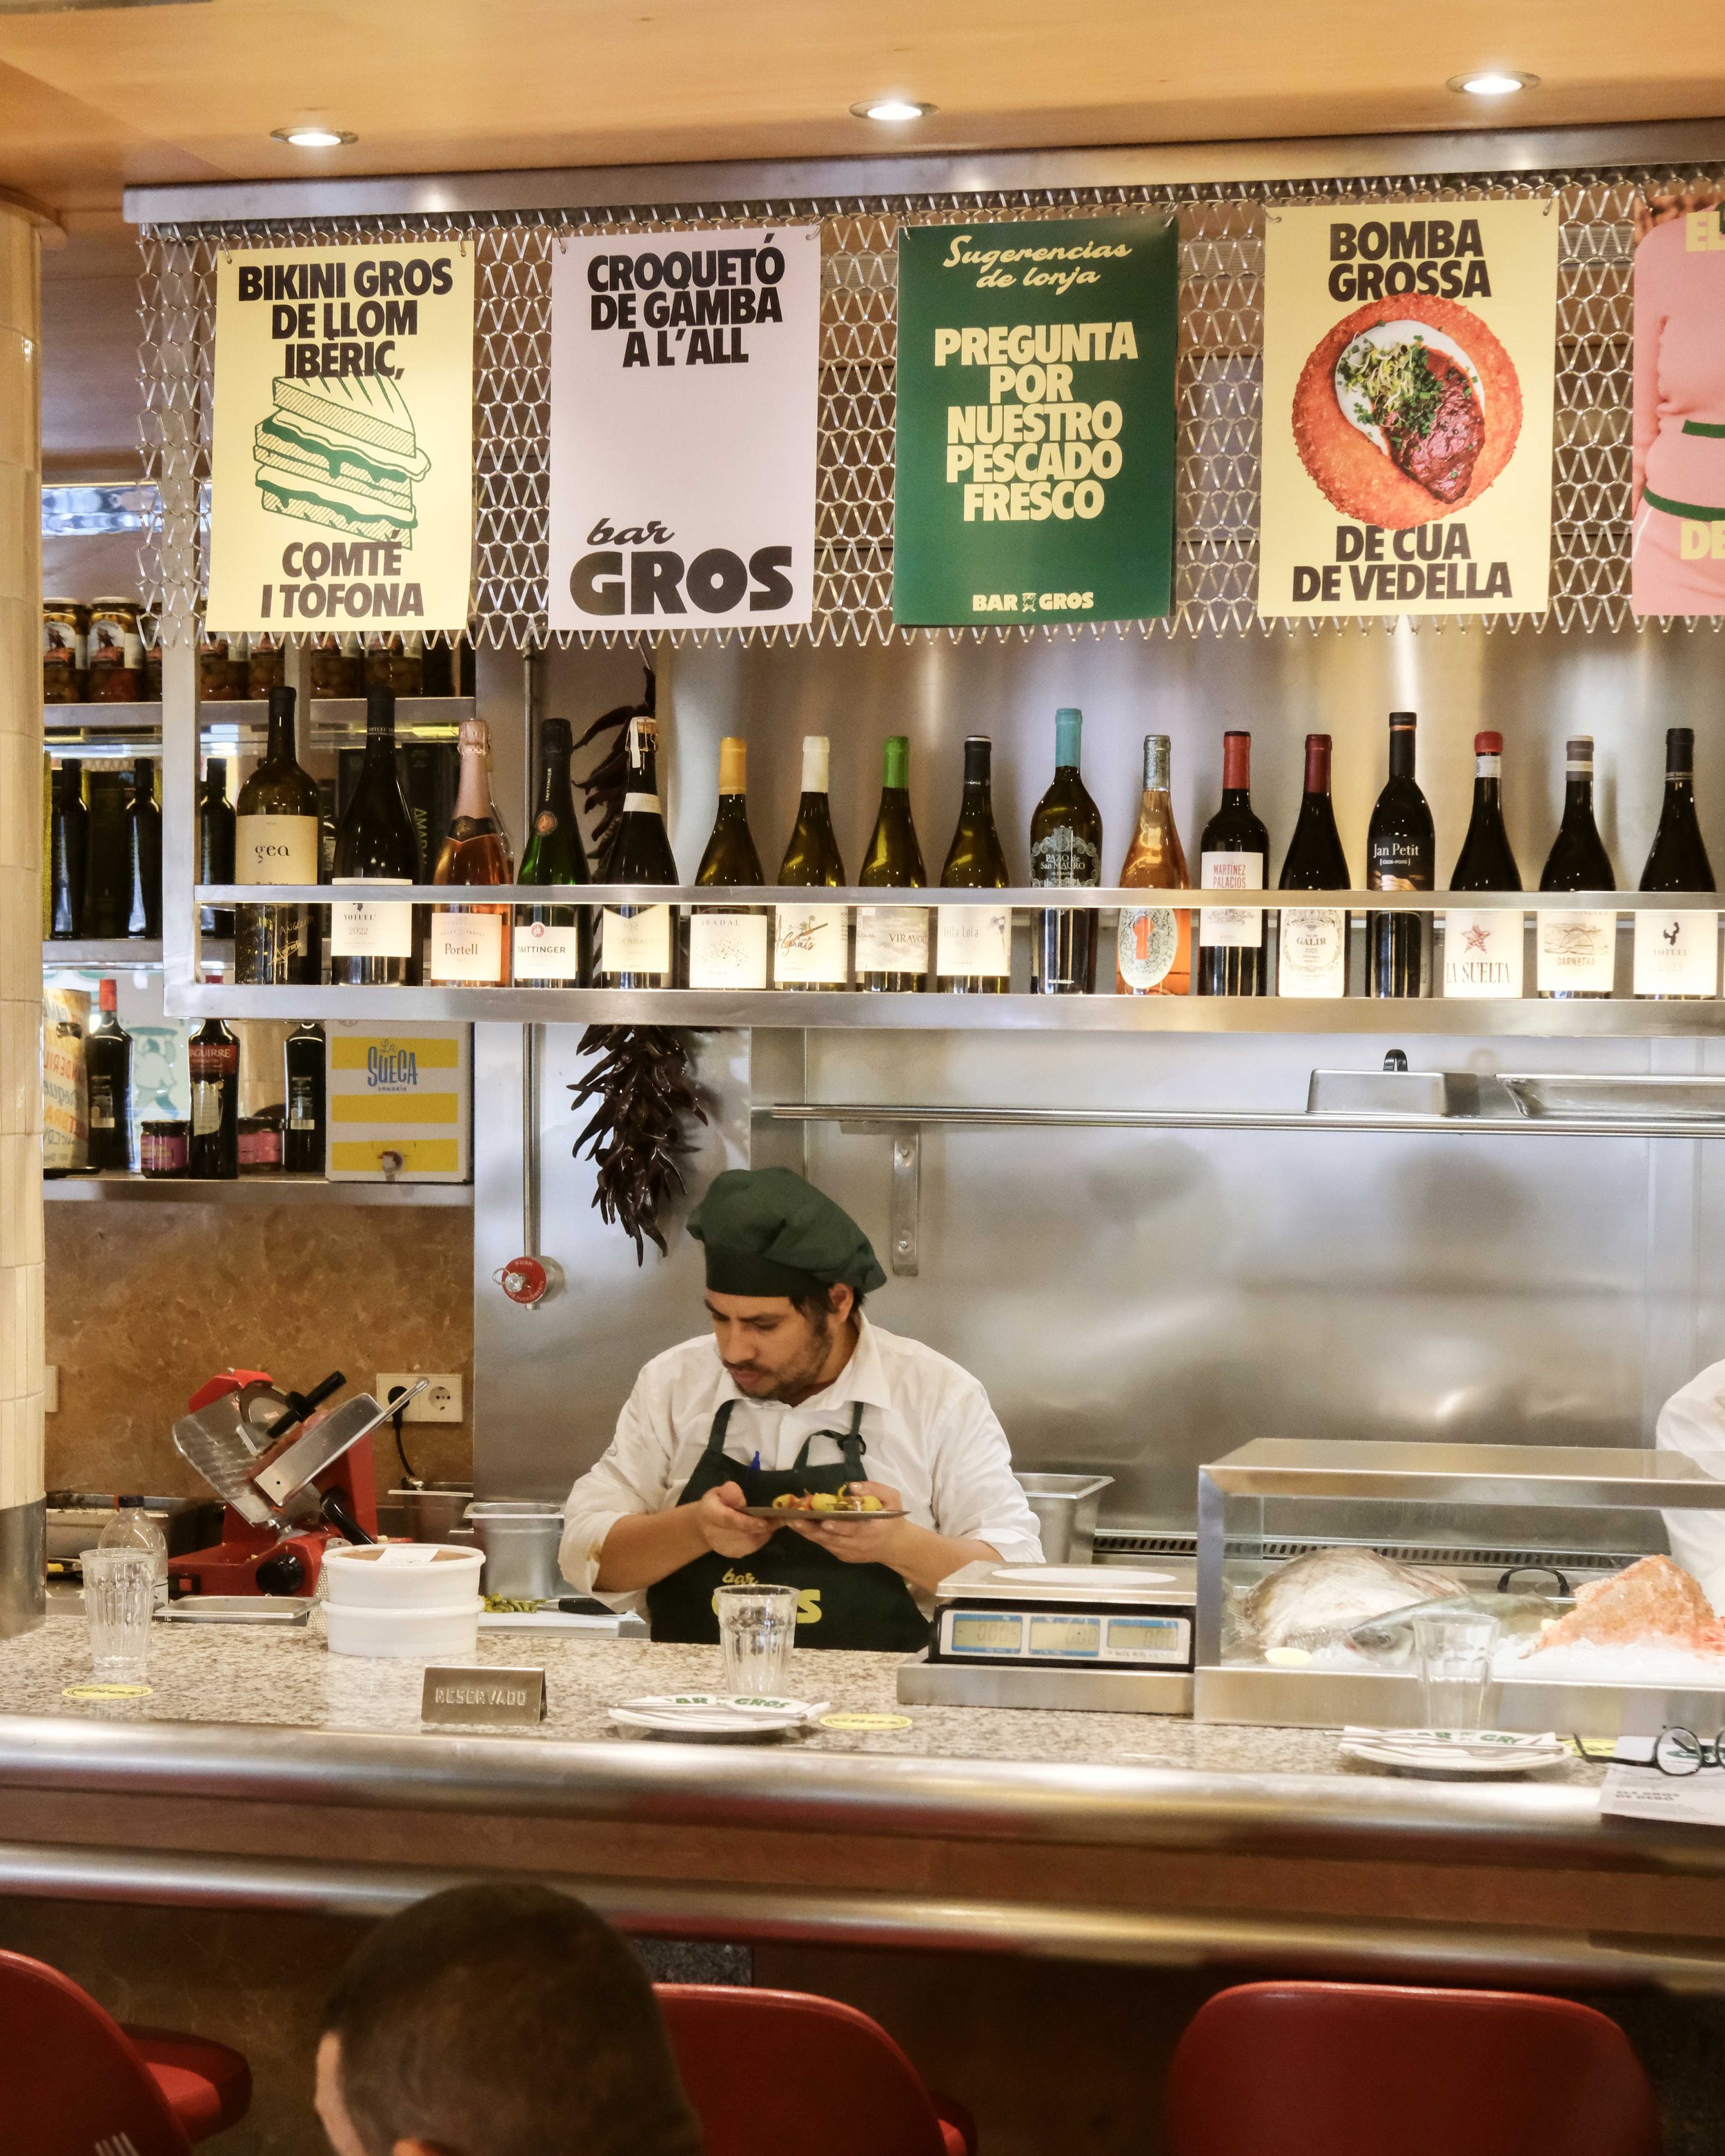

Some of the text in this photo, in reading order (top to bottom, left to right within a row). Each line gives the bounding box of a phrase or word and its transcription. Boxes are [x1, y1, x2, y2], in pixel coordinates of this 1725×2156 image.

[943, 235, 1132, 273] Sugerencias
[1329, 219, 1483, 261] BOMBA
[238, 258, 453, 301] BIKINI GROS
[587, 233, 785, 293] CROQUETÓ
[976, 266, 1101, 295] de lonja
[1328, 260, 1492, 301] GROSSA
[273, 300, 417, 339] DE LLOM
[591, 287, 783, 330] DE GAMBA
[622, 328, 749, 368] A L'ALL
[934, 322, 1138, 366] PREGUNTA
[989, 364, 1073, 404] POR
[947, 401, 1123, 444] NUESTRO
[946, 439, 1123, 483] PESCADO
[963, 479, 1105, 522] FRESCO
[586, 517, 676, 546] bar
[1335, 522, 1472, 562] DE CUA
[569, 546, 793, 616] GROS
[1292, 562, 1513, 602] DE VEDELLA
[261, 584, 273, 617] I
[972, 591, 1094, 611] BAR GROS
[255, 845, 290, 864] gea
[1046, 854, 1070, 862] PAZO
[1214, 862, 1246, 876] MARTÍNEZ
[1373, 843, 1419, 858] Jan Petit
[1213, 877, 1246, 889] PALACIOS
[445, 943, 478, 955] Portell
[962, 926, 978, 938] Lola
[1462, 962, 1510, 983] SUELTA
[381, 1038, 397, 1053] La
[367, 1046, 418, 1087] SUECA
[722, 1567, 758, 1585] bar
[435, 1688, 527, 1706] RESERVADO
[734, 1698, 791, 1708] GROS
